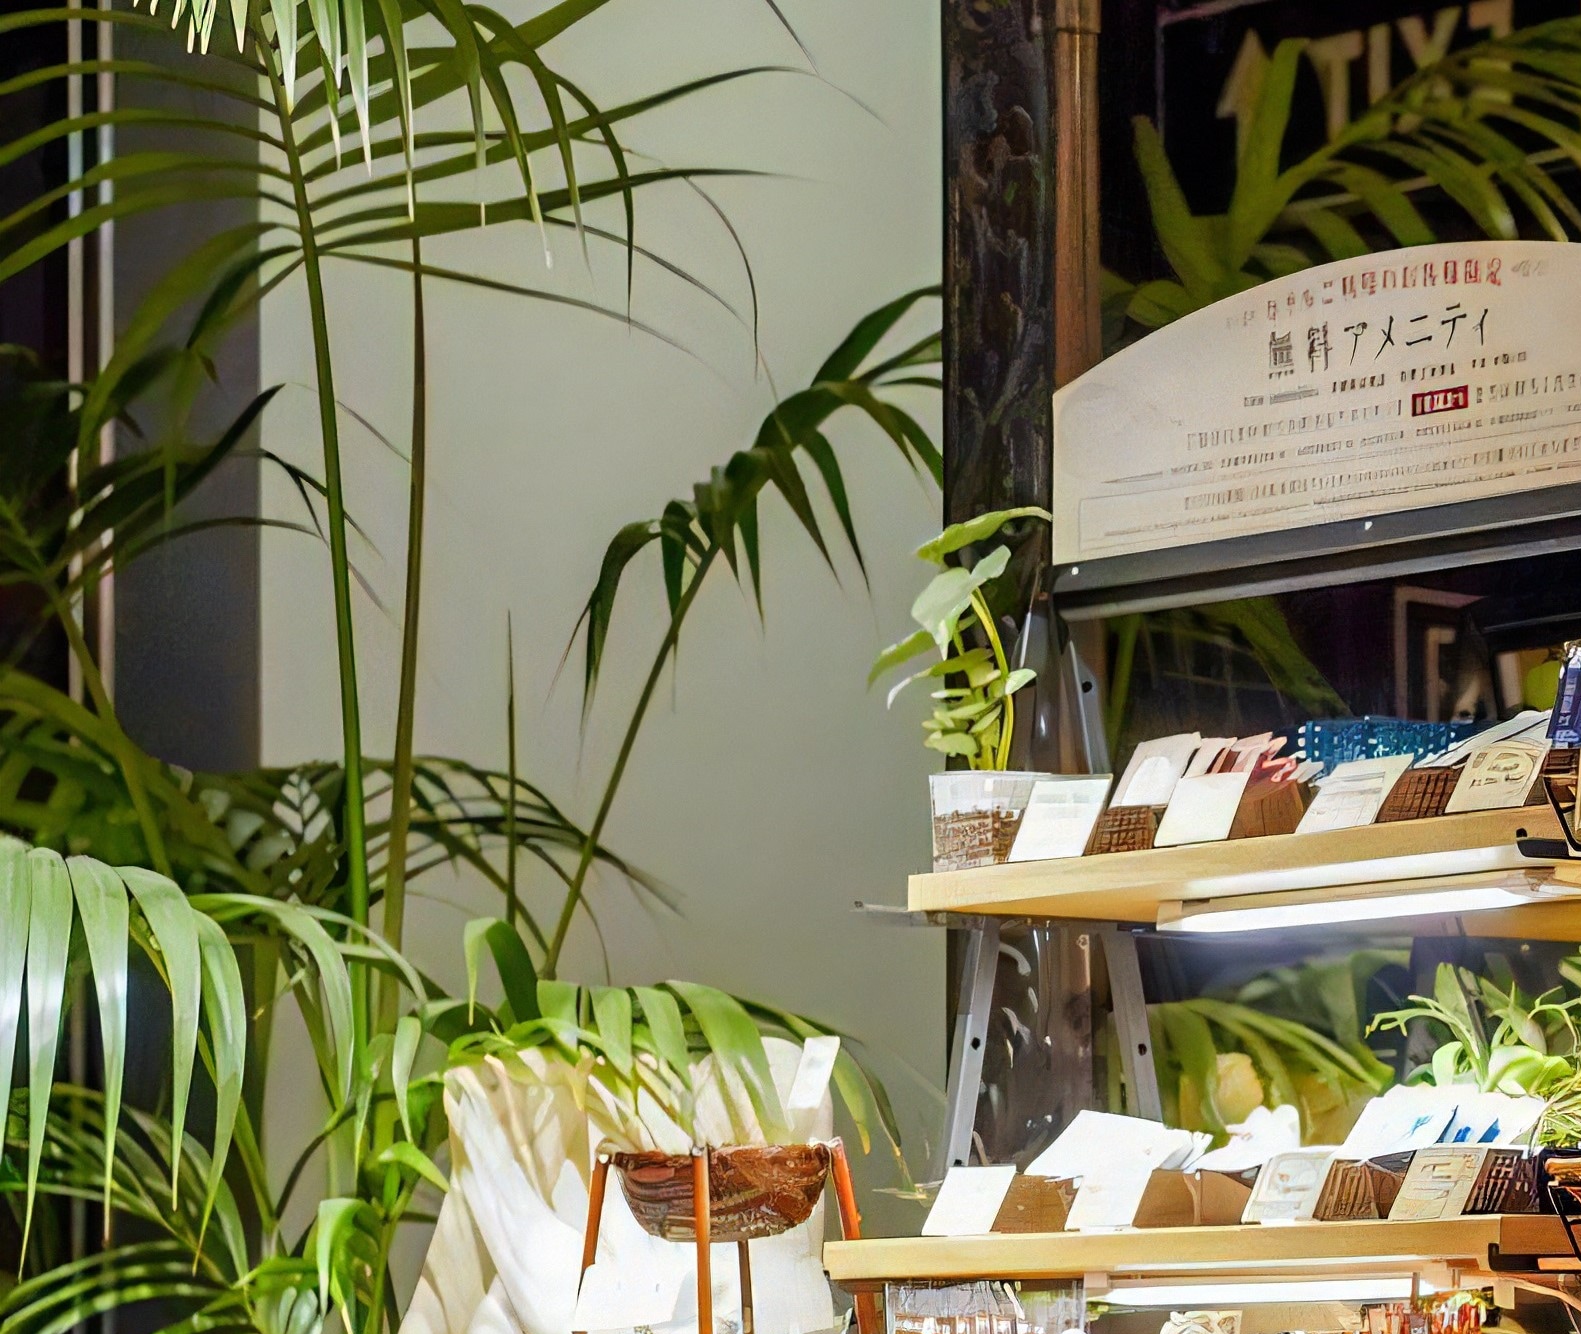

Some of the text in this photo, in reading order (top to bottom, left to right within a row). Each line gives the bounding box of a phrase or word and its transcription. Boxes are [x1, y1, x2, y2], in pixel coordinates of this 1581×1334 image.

[1268, 302, 1490, 380] 無料アメニティ
